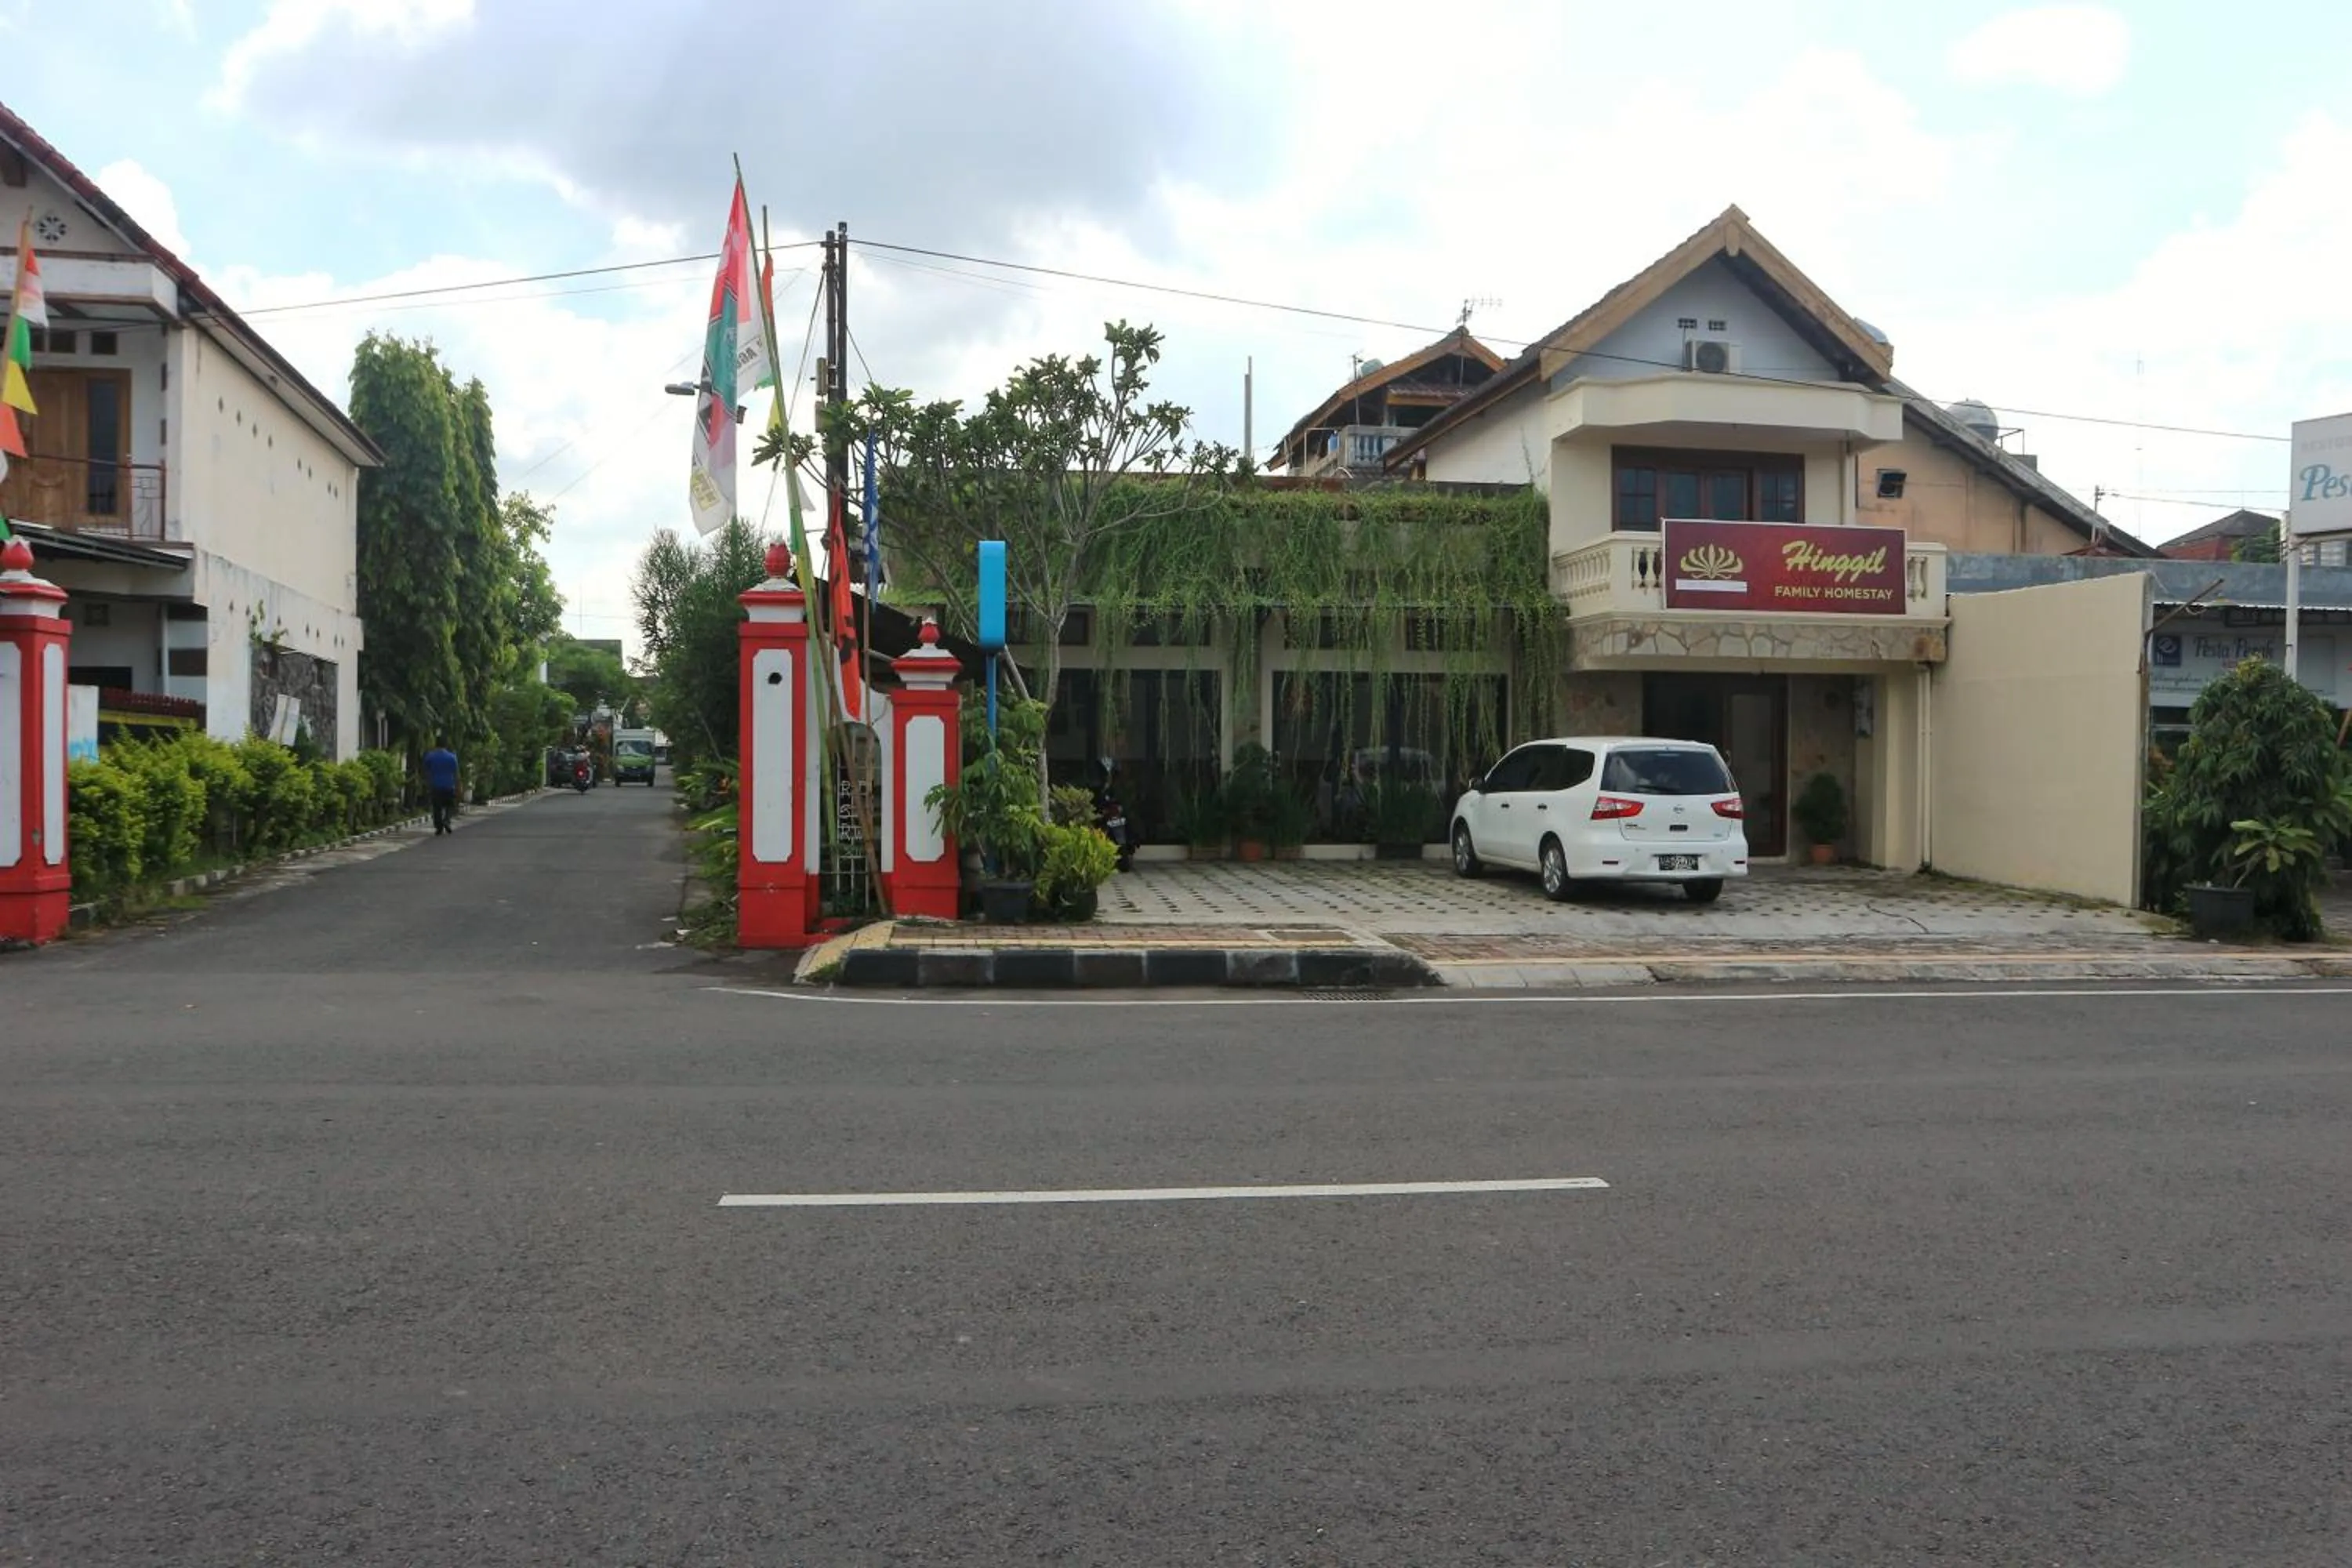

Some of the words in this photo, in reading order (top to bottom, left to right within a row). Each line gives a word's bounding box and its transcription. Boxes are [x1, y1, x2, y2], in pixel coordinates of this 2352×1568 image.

[1782, 540, 1887, 583] Hinggil
[1774, 585, 1821, 598] FAMILY
[1824, 587, 1894, 600] HOMESTAY
